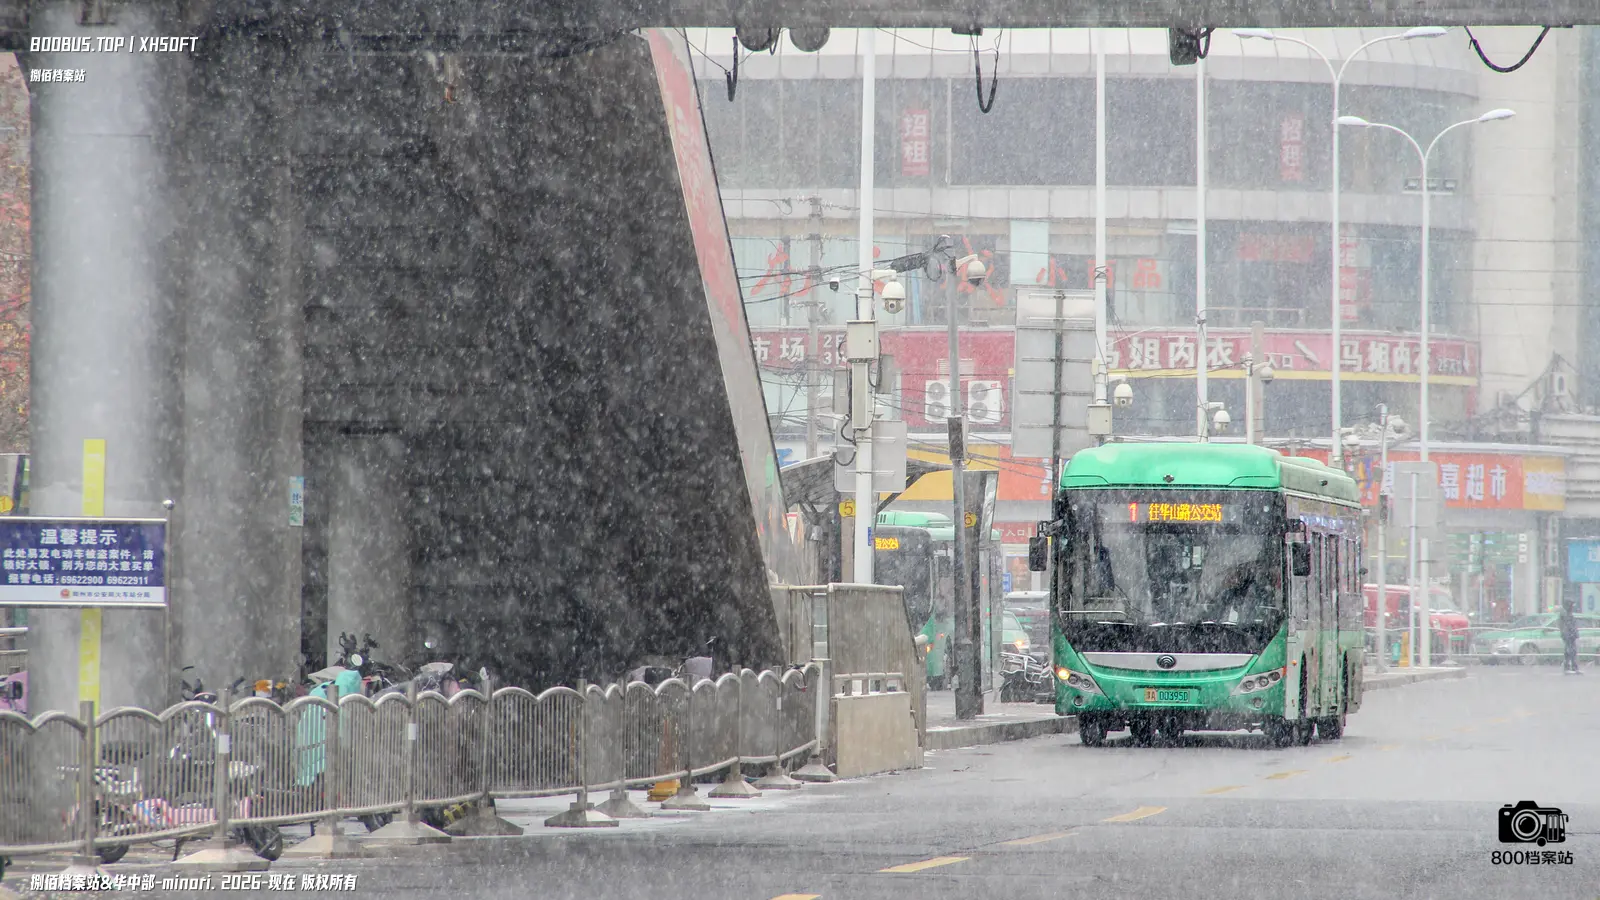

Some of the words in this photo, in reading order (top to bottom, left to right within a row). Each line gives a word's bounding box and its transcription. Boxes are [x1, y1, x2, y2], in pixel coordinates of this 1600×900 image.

[902, 114, 928, 163] 招租
[753, 336, 805, 363] 市场
[844, 501, 854, 515] 5
[1129, 502, 1138, 522] 1
[1149, 502, 1223, 522] 往华山路公交站
[40, 528, 118, 545] 温馨提示
[107, 575, 148, 585] 69622911
